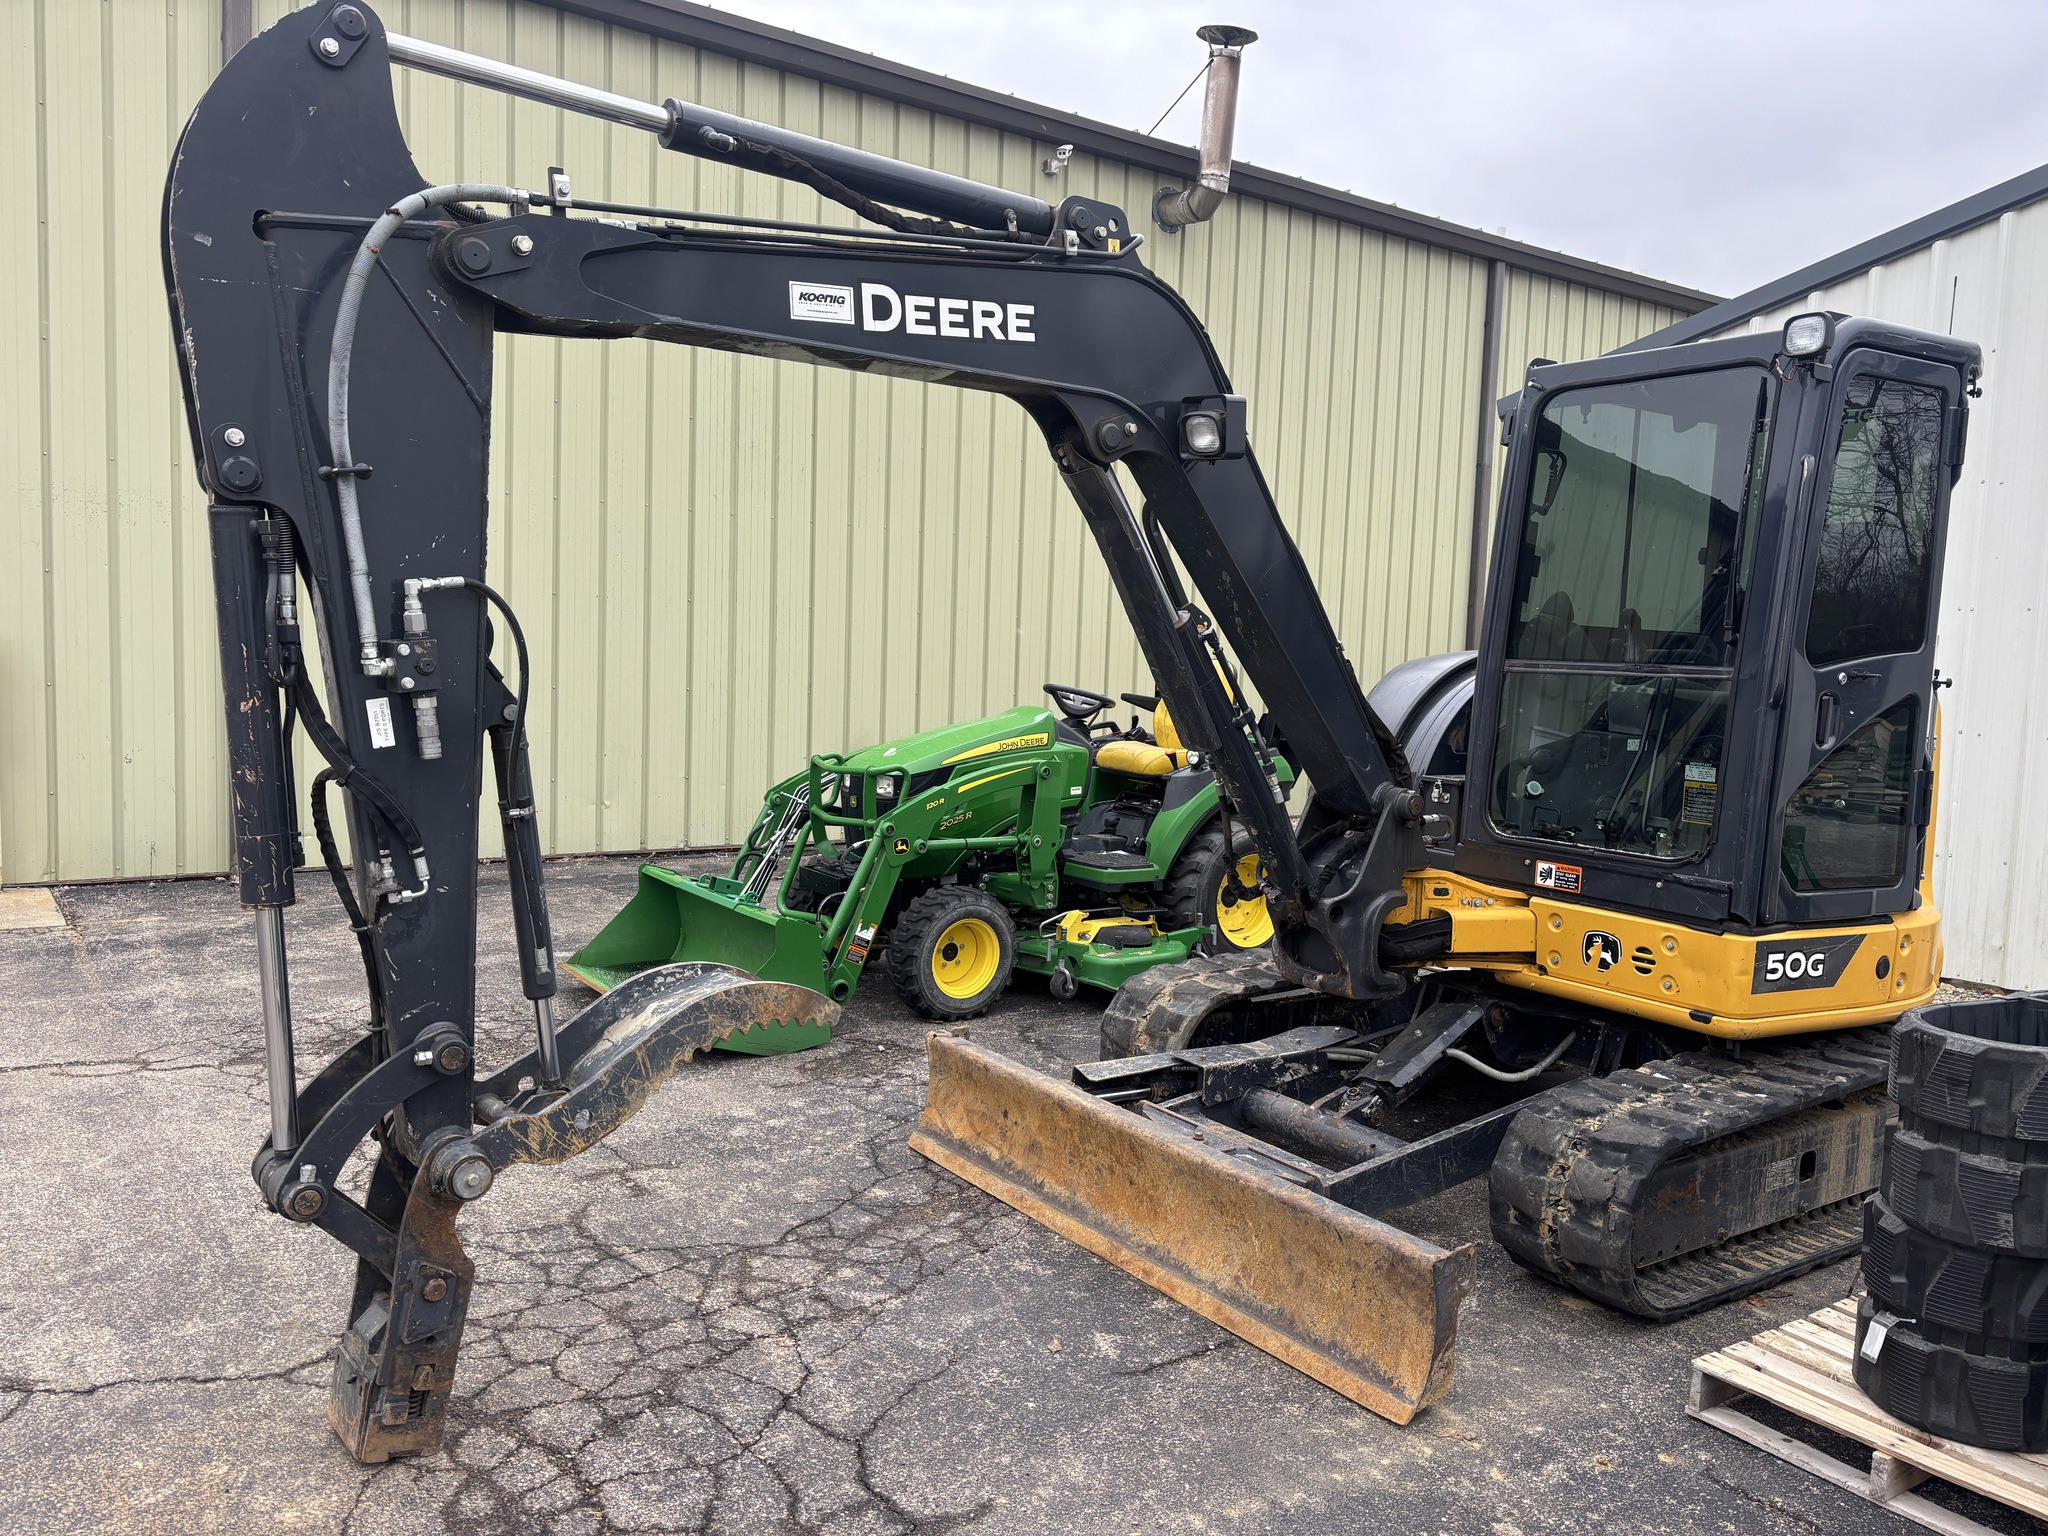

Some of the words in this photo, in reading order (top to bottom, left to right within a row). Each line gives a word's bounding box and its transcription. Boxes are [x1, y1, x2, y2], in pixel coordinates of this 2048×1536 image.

[861, 282, 1036, 342] DEERE
[997, 740, 1019, 751] JOHN
[1020, 737, 1045, 747] DEERE
[926, 800, 939, 810] 120
[940, 814, 965, 830] 2025
[966, 811, 973, 819] R
[1765, 951, 1825, 981] 50G
